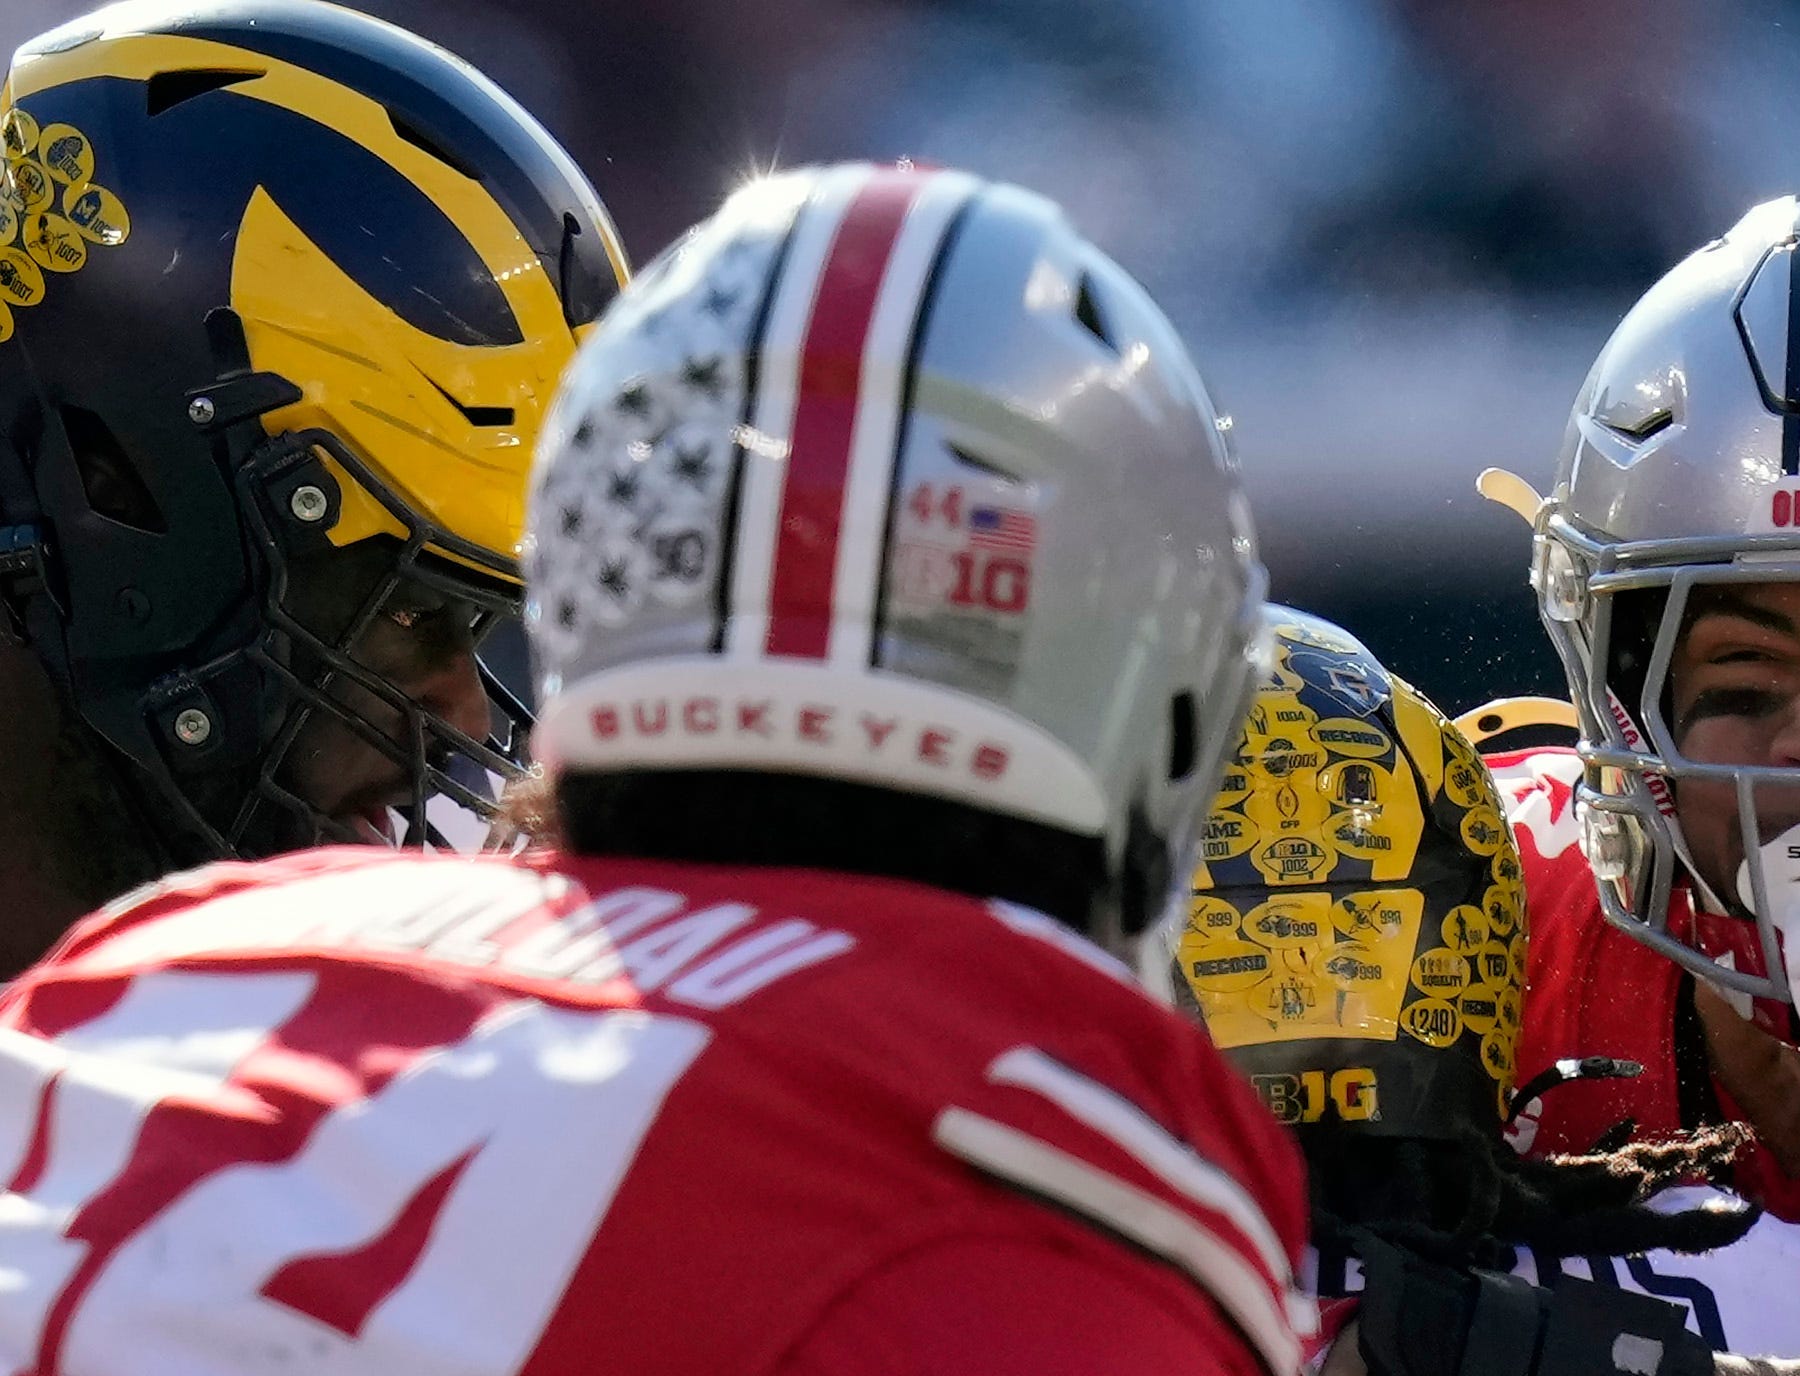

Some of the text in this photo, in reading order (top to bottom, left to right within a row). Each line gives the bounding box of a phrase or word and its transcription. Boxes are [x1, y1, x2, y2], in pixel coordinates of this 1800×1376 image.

[590, 696, 1012, 782] BUCKEYES
[1201, 821, 1243, 840] AME
[1280, 820, 1300, 829] CFP
[1282, 858, 1309, 873] 1002
[1206, 911, 1233, 928] 999
